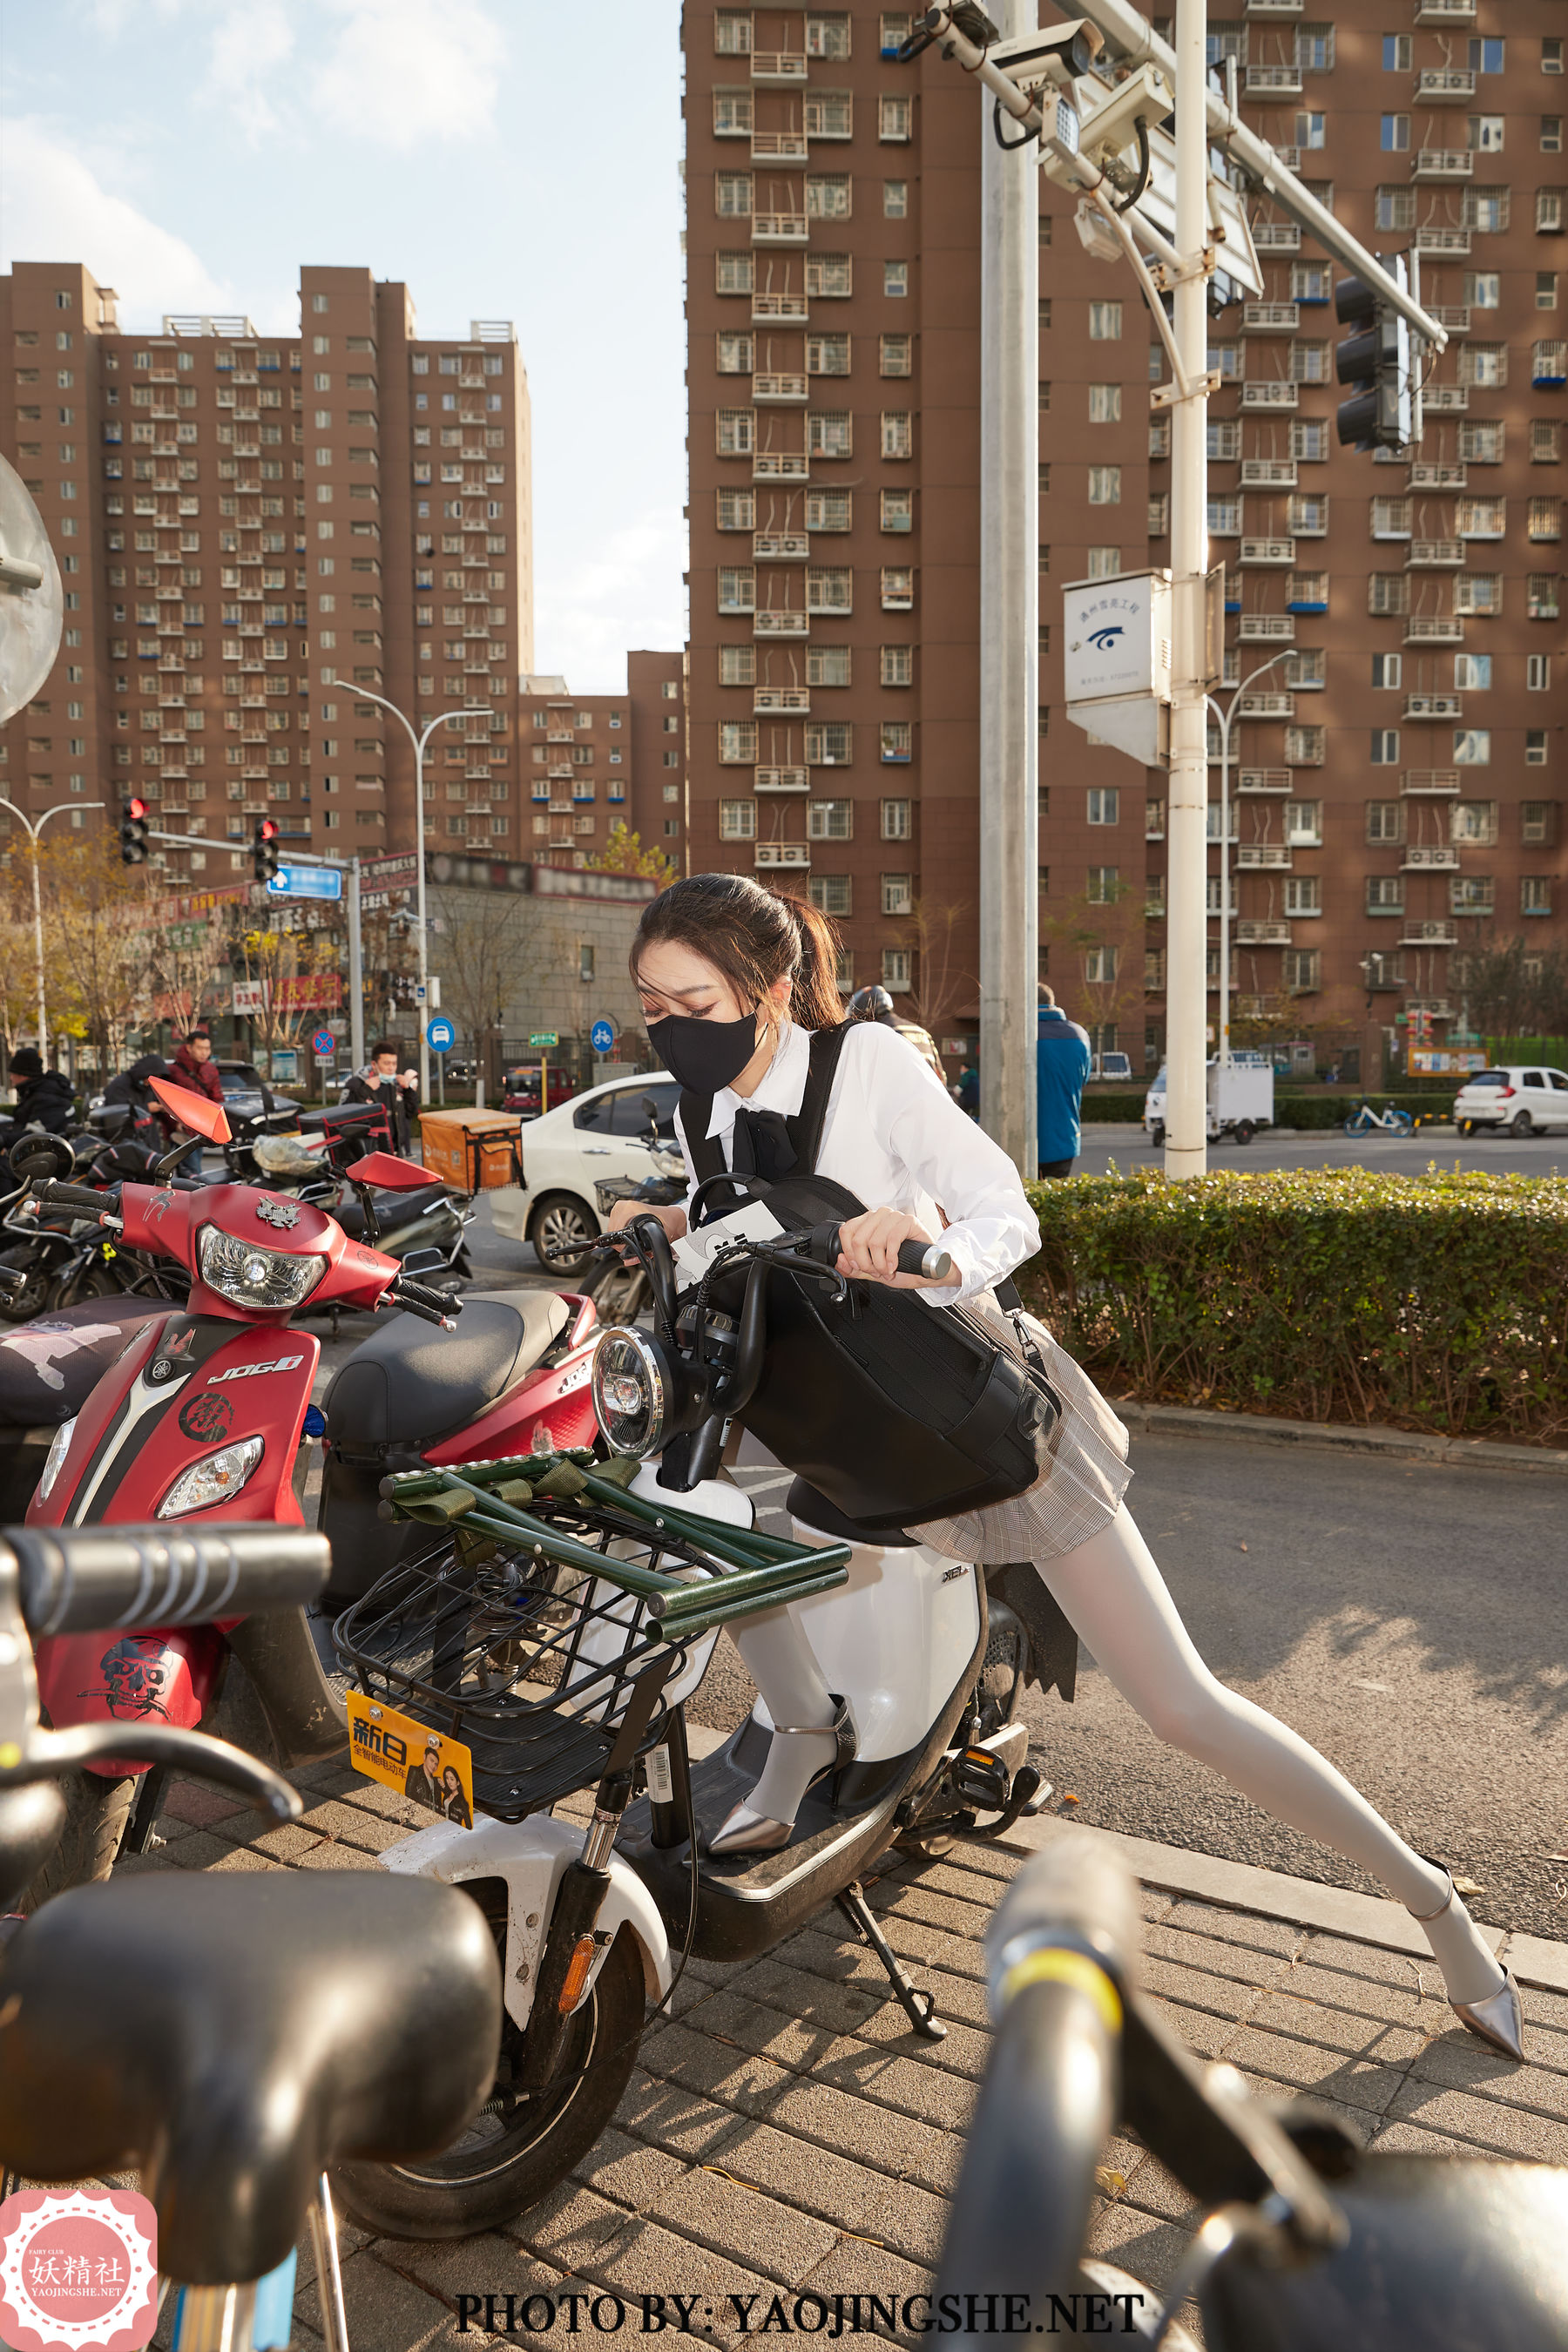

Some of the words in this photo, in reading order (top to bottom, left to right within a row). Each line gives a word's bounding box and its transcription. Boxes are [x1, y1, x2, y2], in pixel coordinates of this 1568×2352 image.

[353, 1716, 407, 1766] 新日
[354, 1744, 407, 1780] 全智能电动车
